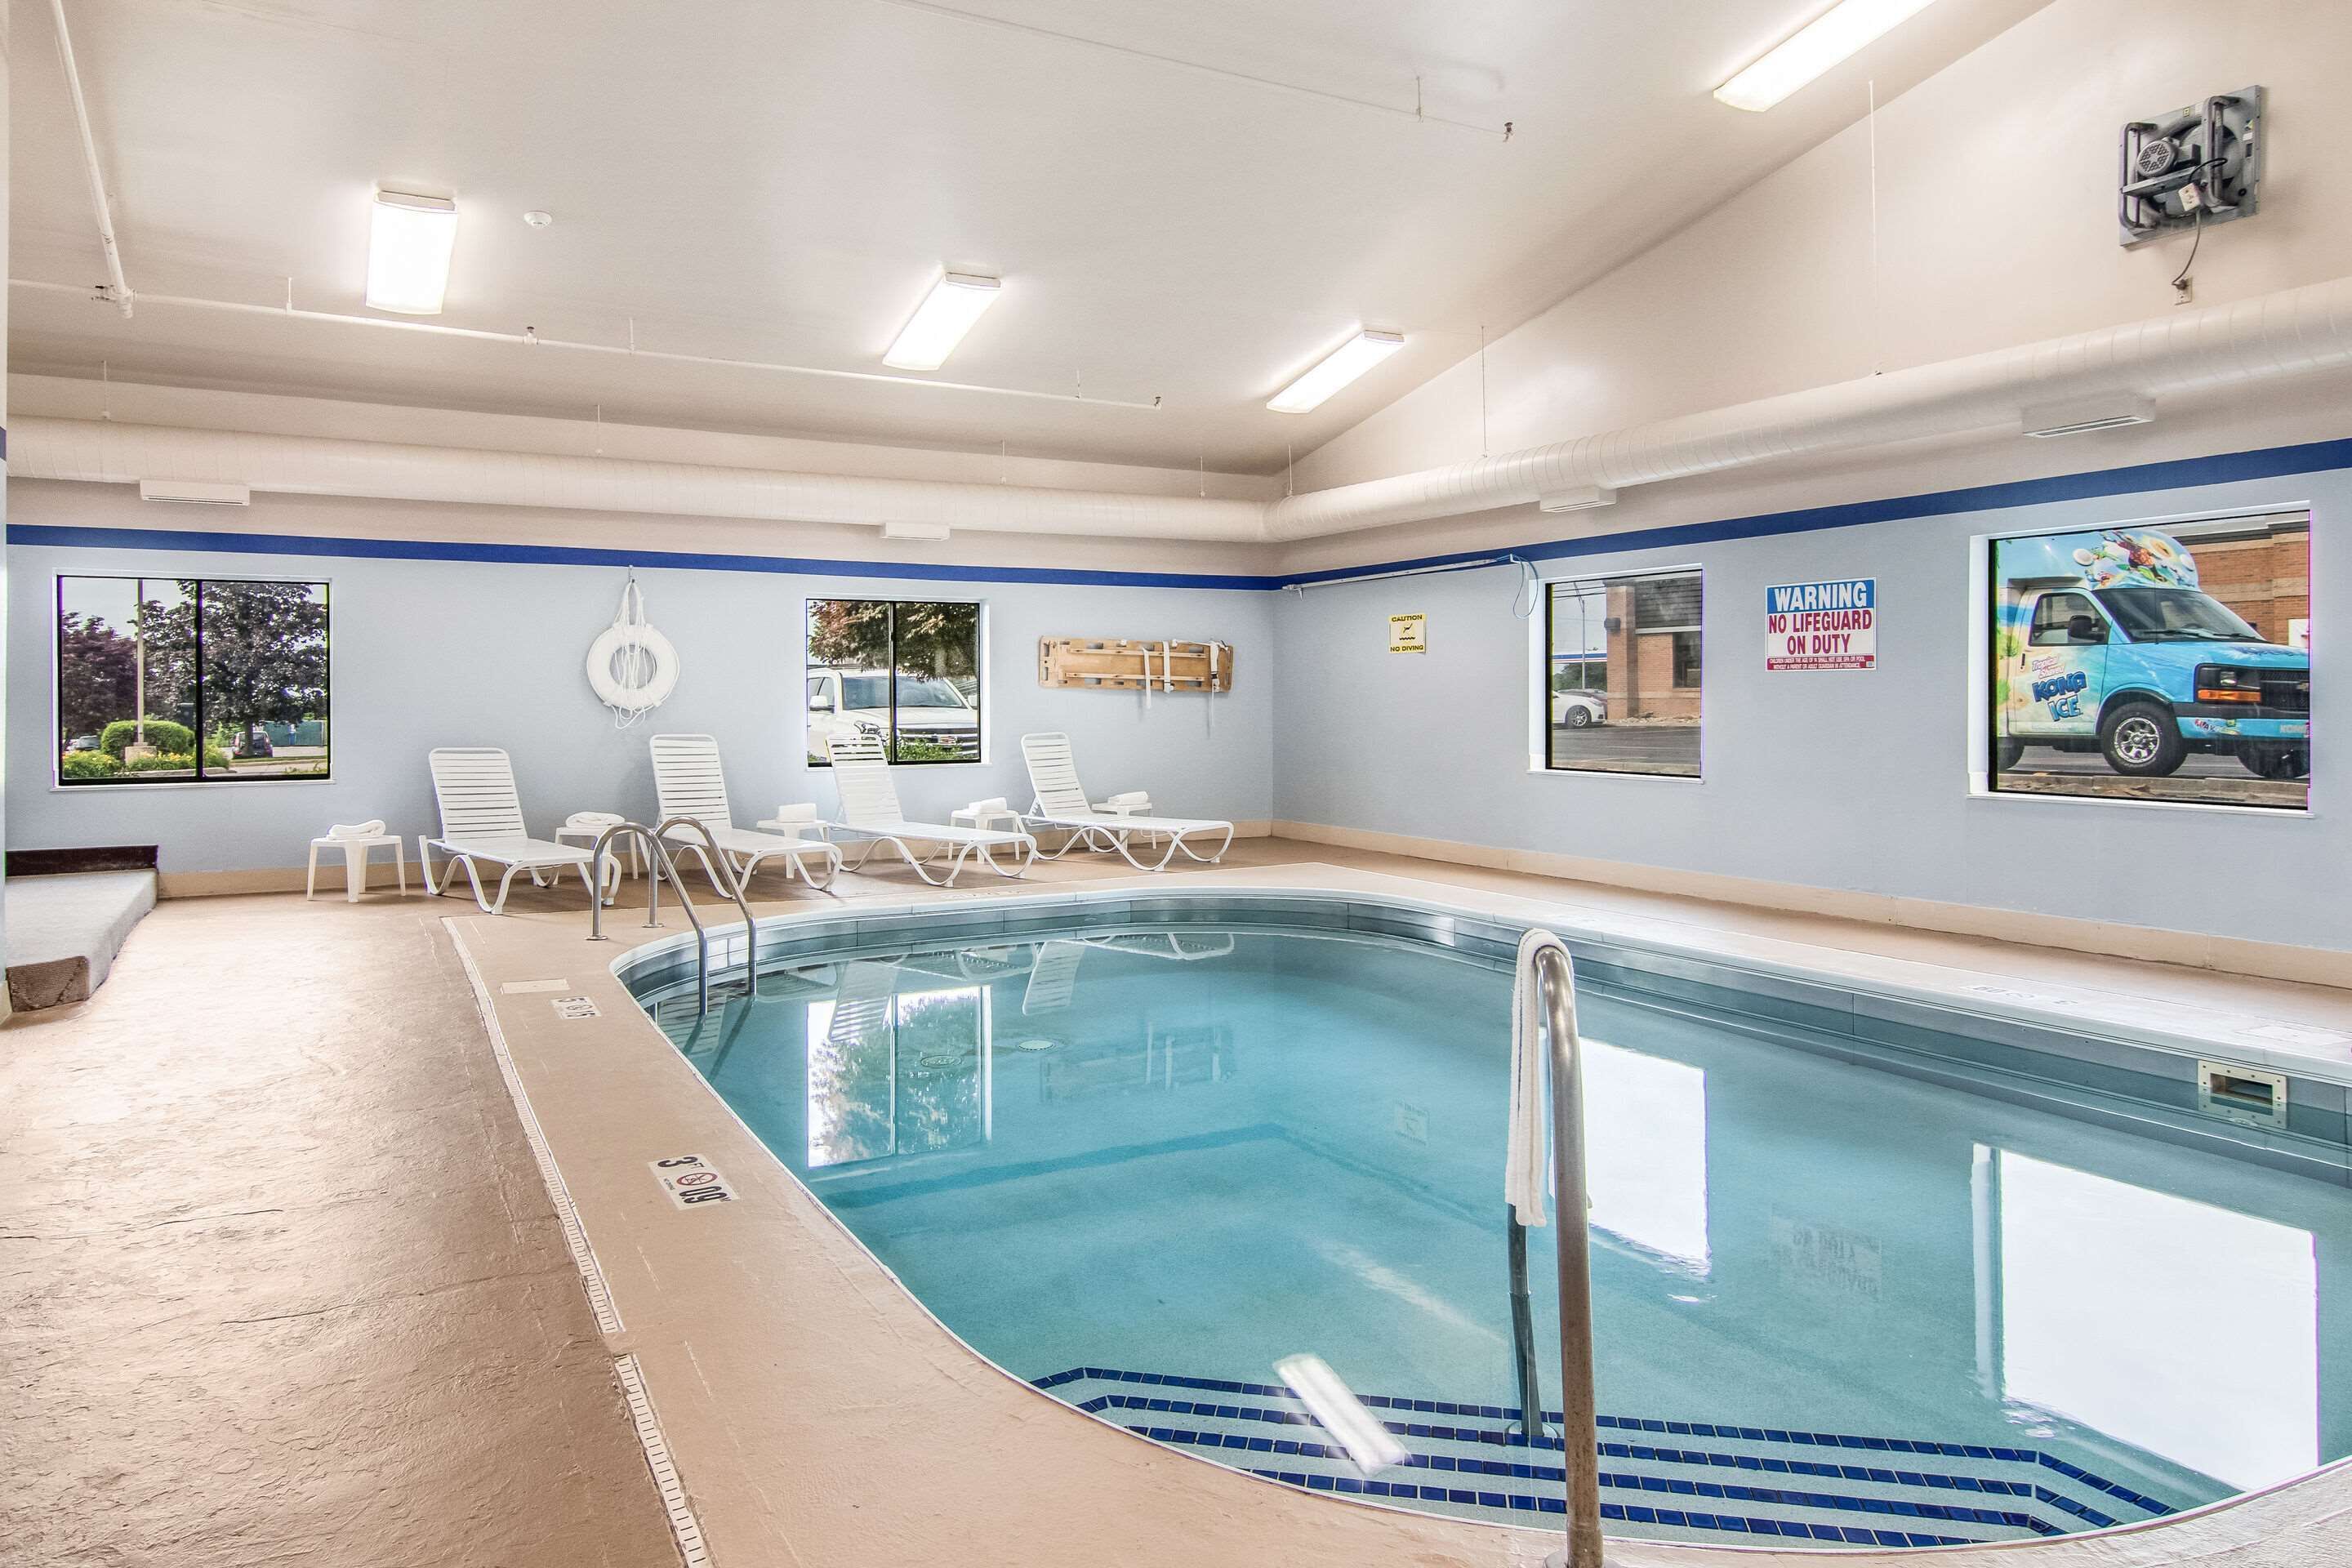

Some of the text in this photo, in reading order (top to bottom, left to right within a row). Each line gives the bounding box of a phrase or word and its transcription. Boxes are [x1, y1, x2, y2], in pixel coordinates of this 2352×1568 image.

[1775, 581, 1867, 612] WARNING
[1392, 614, 1423, 622] CAUTION
[1769, 609, 1873, 634] NO LIFEGUARD
[1787, 634, 1851, 655] ON DUTY
[2032, 670, 2087, 702] KONA
[2047, 694, 2080, 722] ICE
[657, 1156, 698, 1168] 3
